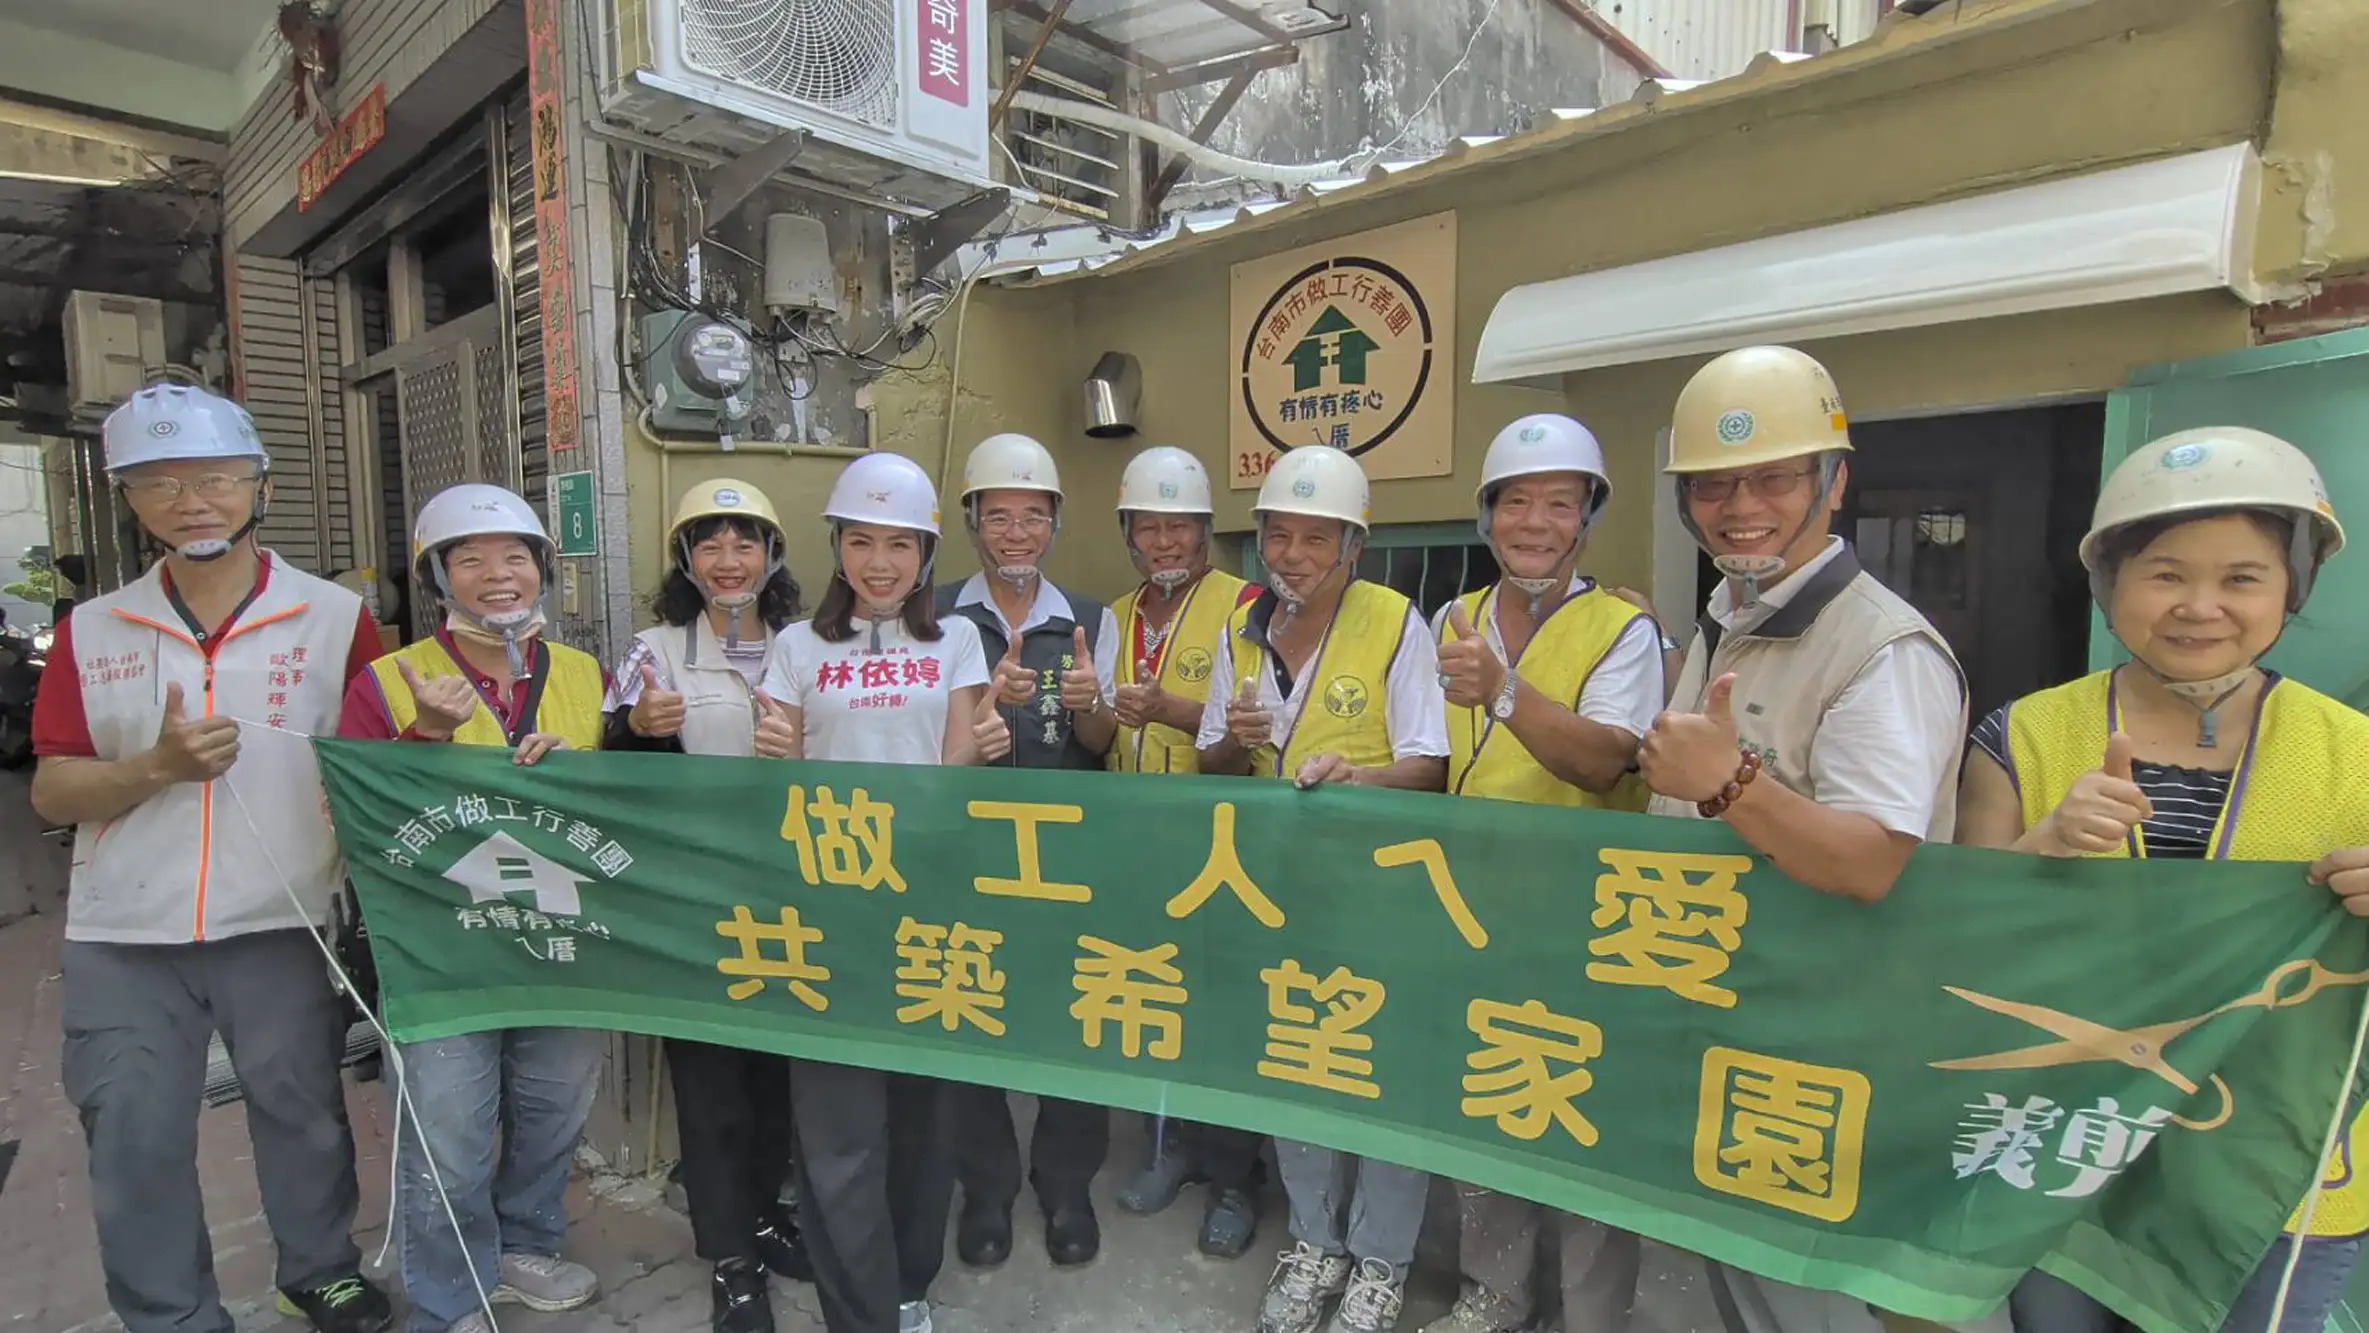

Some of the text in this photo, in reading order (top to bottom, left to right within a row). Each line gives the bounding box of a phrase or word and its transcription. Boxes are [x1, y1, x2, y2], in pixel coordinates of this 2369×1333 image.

[1256, 273, 1414, 361] 台南市做工行善團
[1279, 390, 1384, 422] 有情有疼心
[572, 511, 583, 540] 8
[816, 656, 941, 693] 林依婷
[714, 904, 1872, 1224] 共築希望家園
